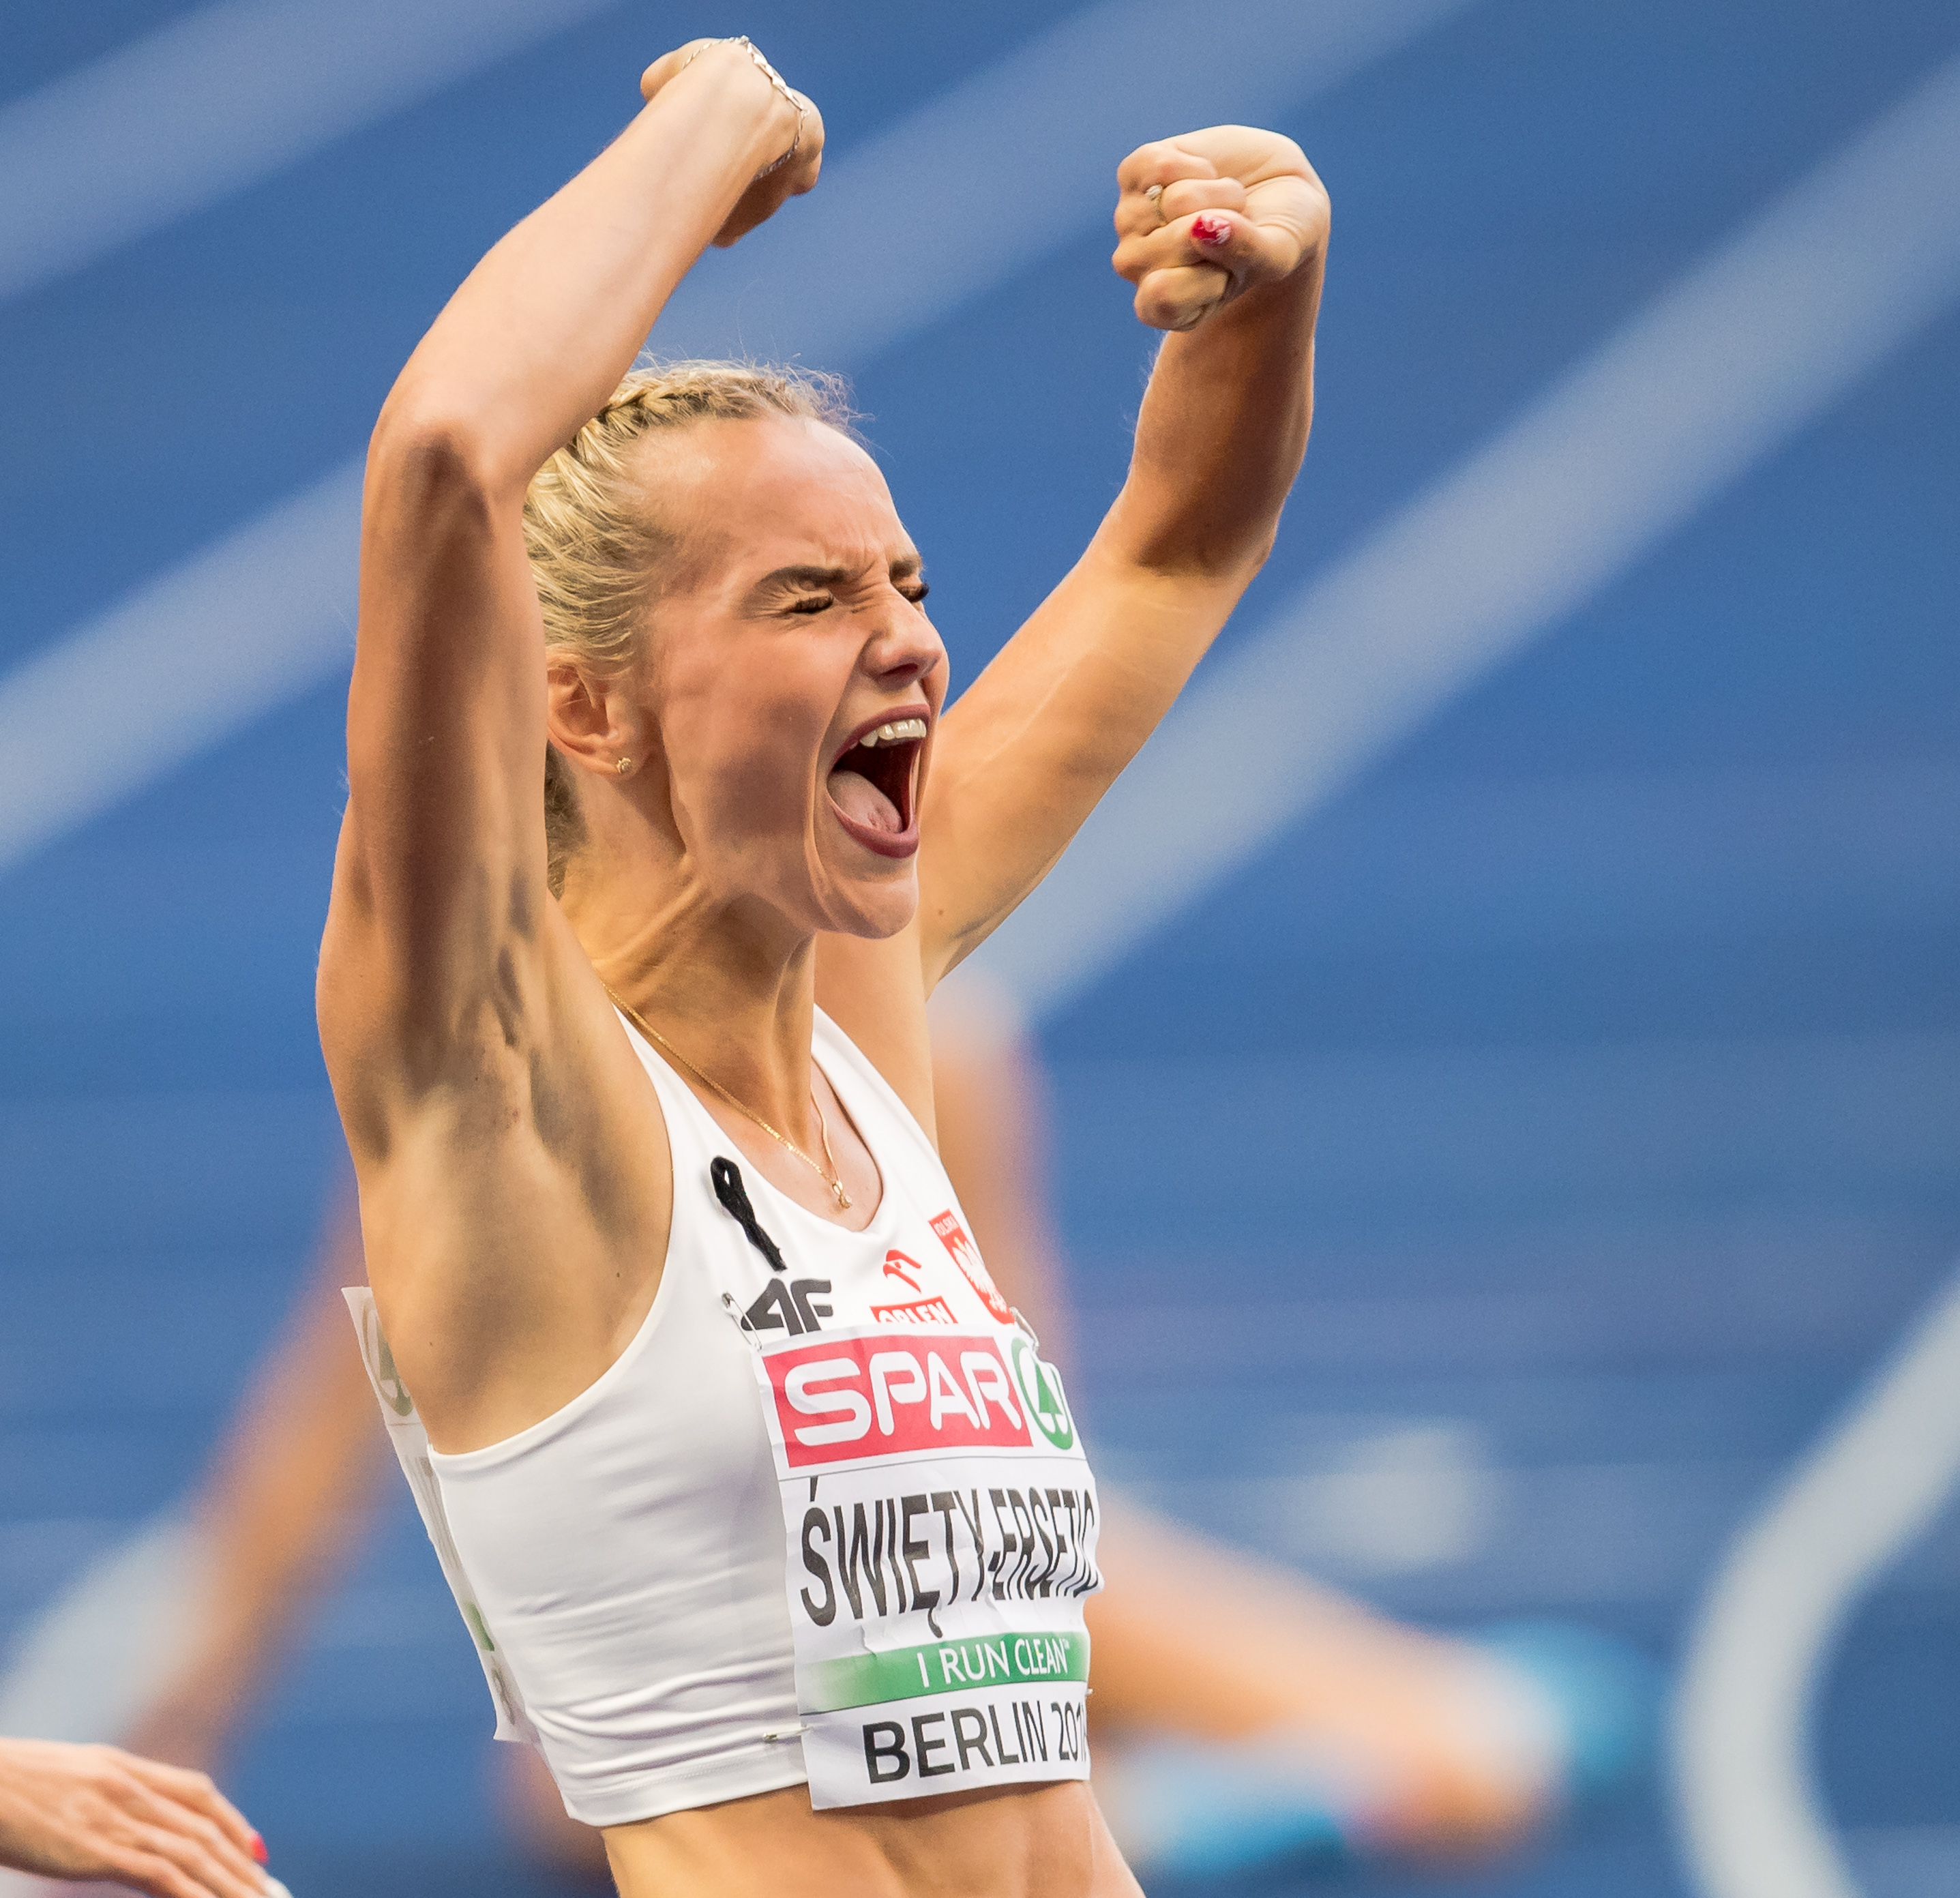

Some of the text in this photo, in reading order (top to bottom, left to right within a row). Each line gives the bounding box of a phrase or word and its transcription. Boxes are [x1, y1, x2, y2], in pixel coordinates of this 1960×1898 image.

[741, 1277, 833, 1336] 4F
[784, 1350, 1022, 1447] SPAR
[917, 1652, 930, 1688] I
[939, 1642, 1011, 1684] RUN
[862, 1700, 1087, 1785] BERLIN 201
